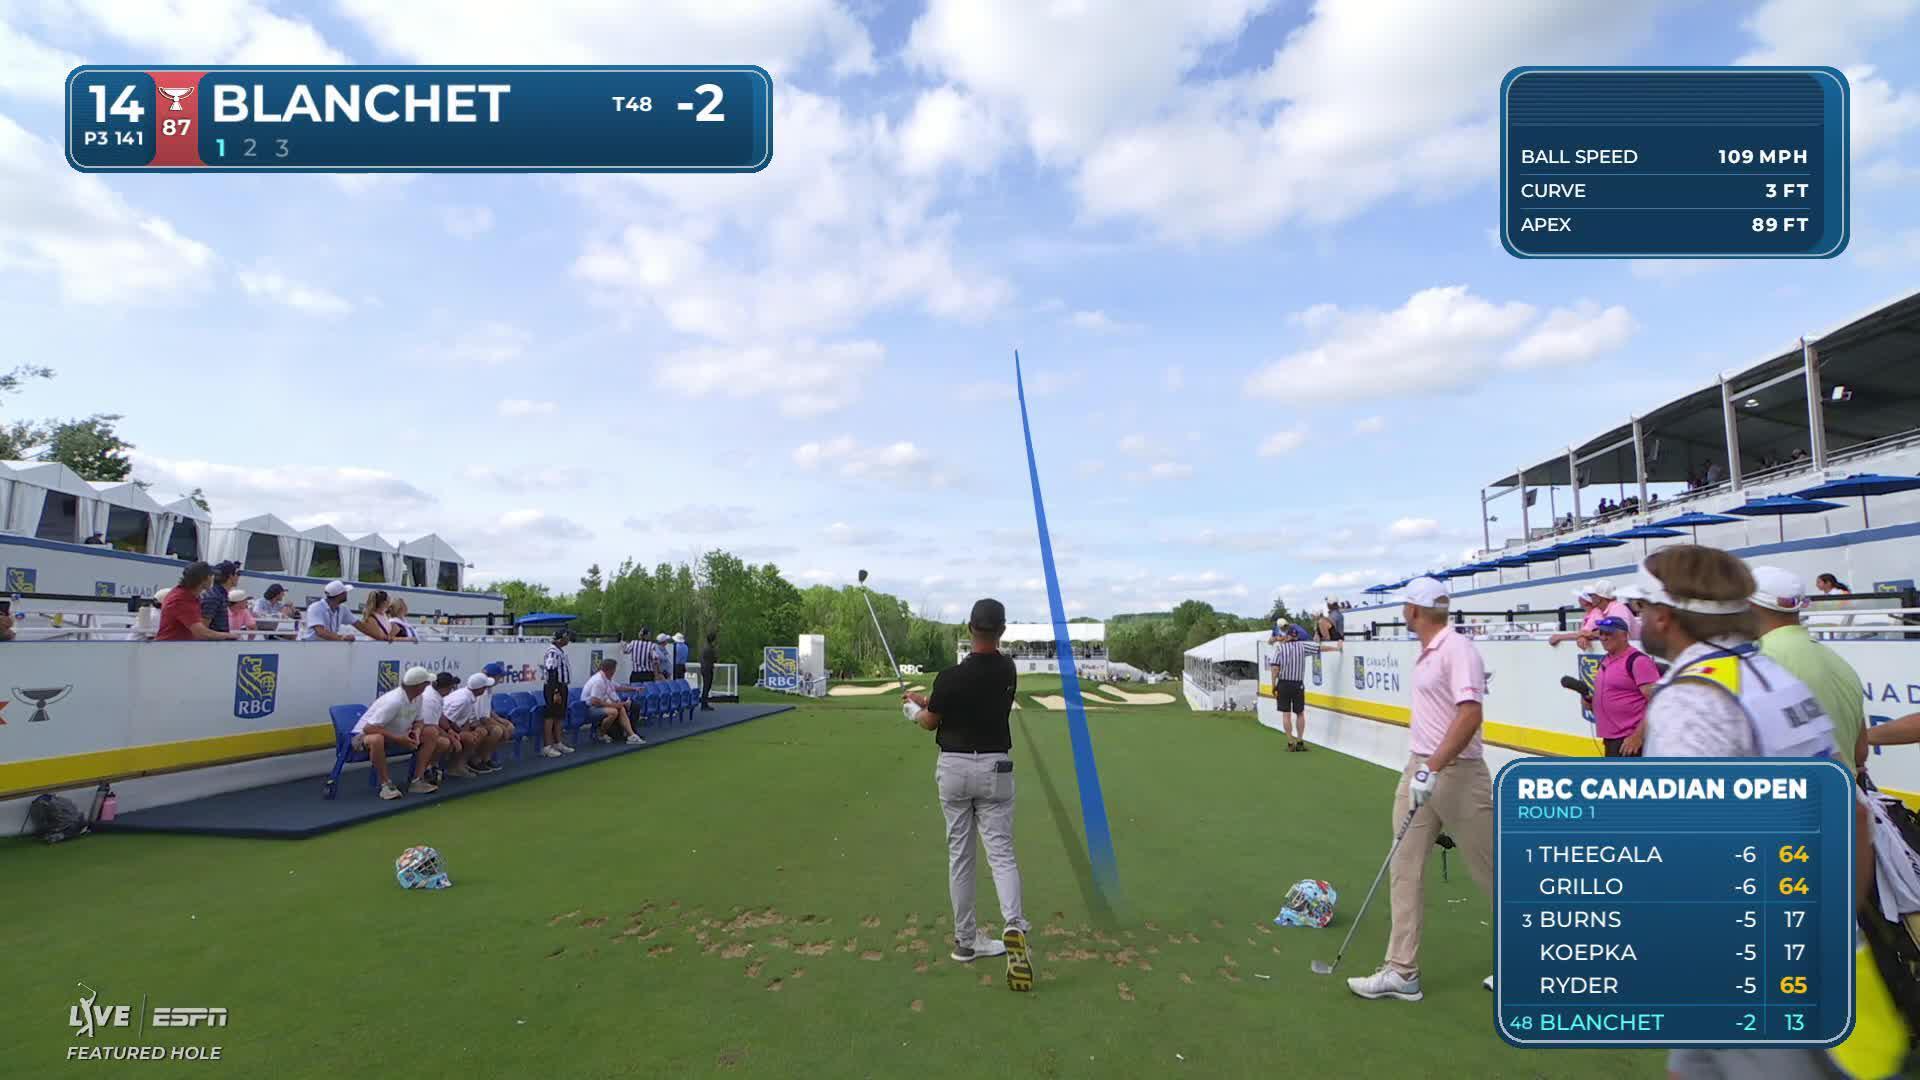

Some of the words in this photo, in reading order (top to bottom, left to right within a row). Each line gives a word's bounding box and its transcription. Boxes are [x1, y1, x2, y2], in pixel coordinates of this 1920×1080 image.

[900, 664, 923, 675] RBC
[768, 677, 795, 687] RBC
[1366, 671, 1399, 692] OPEN
[239, 699, 273, 715] RBC
